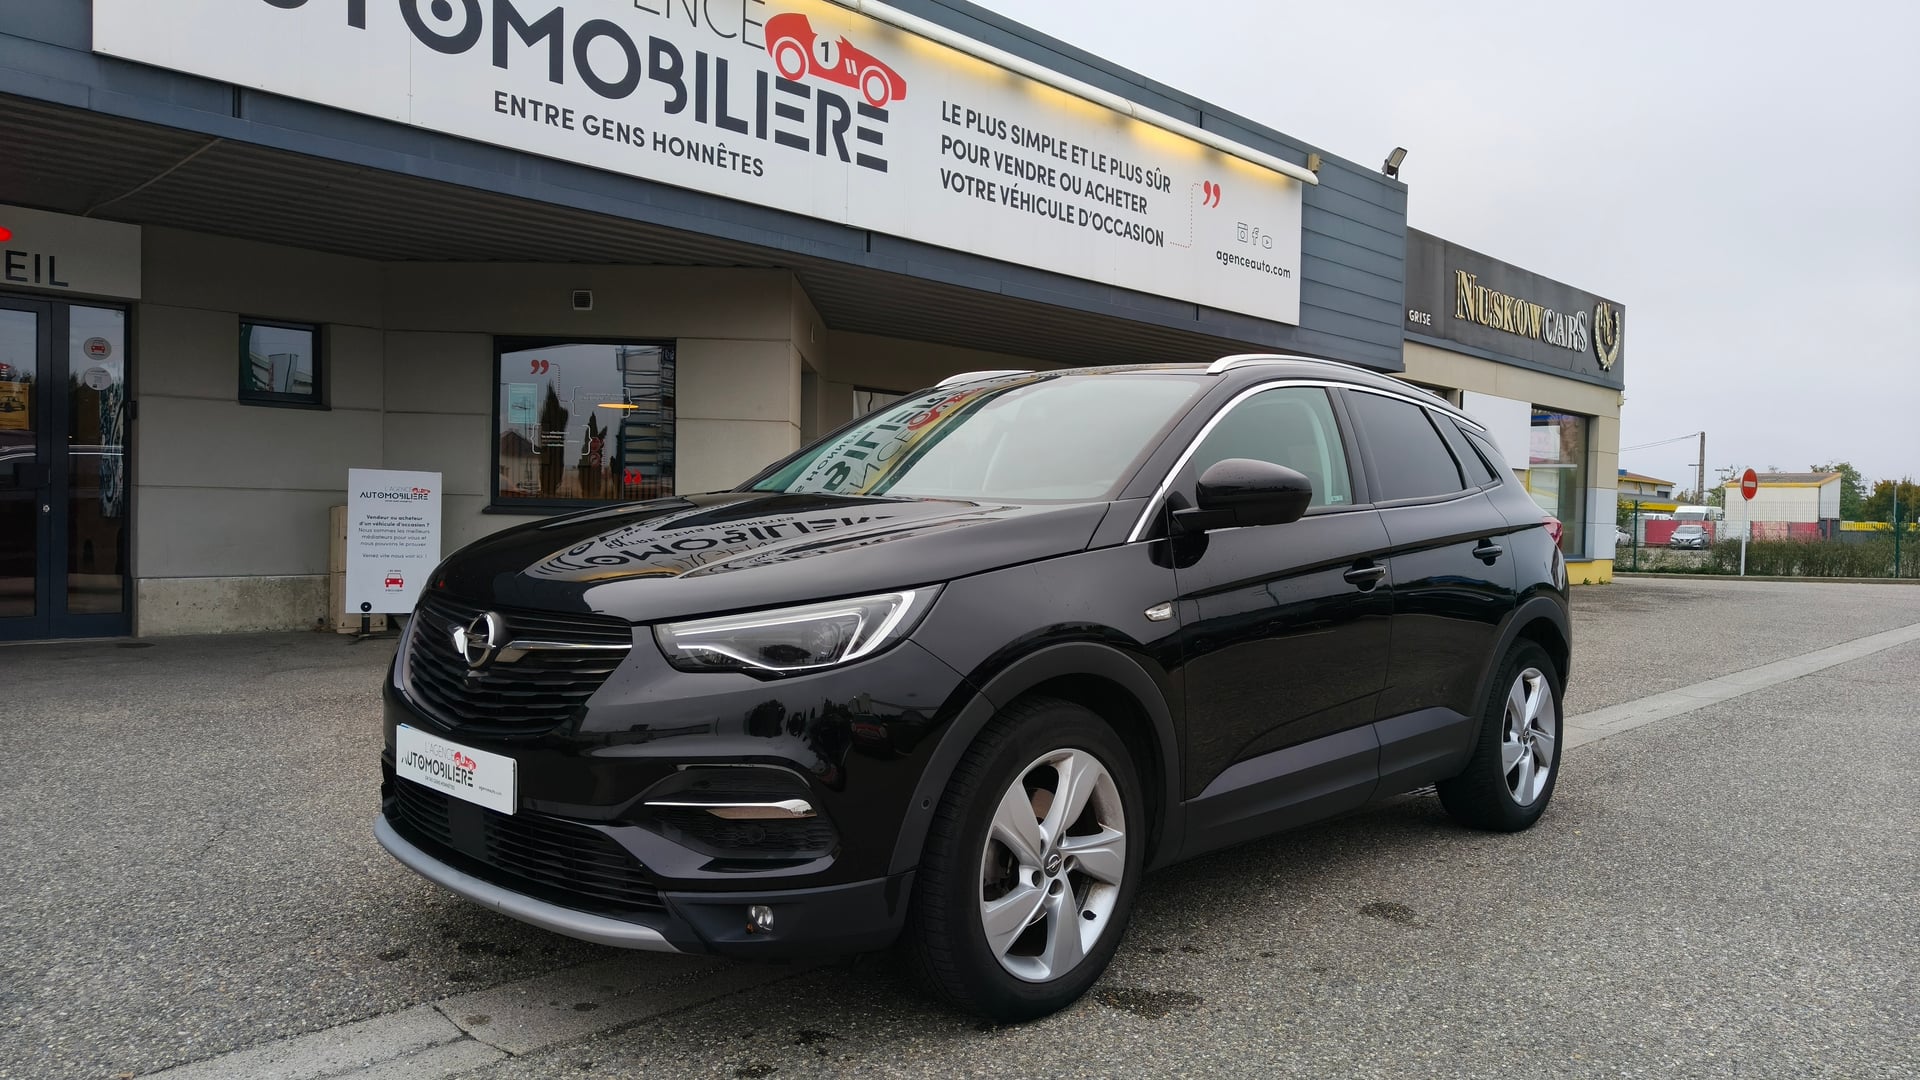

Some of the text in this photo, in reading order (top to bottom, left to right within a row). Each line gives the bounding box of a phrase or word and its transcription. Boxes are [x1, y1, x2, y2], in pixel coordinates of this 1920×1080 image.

[821, 41, 829, 63] 1
[494, 90, 764, 177] ENTRE GENS HONNÊTES
[942, 100, 1171, 193] LE PLUS SIMPLE ET LE PLUS SÛR
[940, 167, 1164, 248] VOTRE VÉHICULE D'OCCASION
[941, 134, 1147, 215] POUR VENDRE OU ACHETER
[1216, 250, 1291, 278] agenceauto.com
[1409, 309, 1432, 326] GRISE
